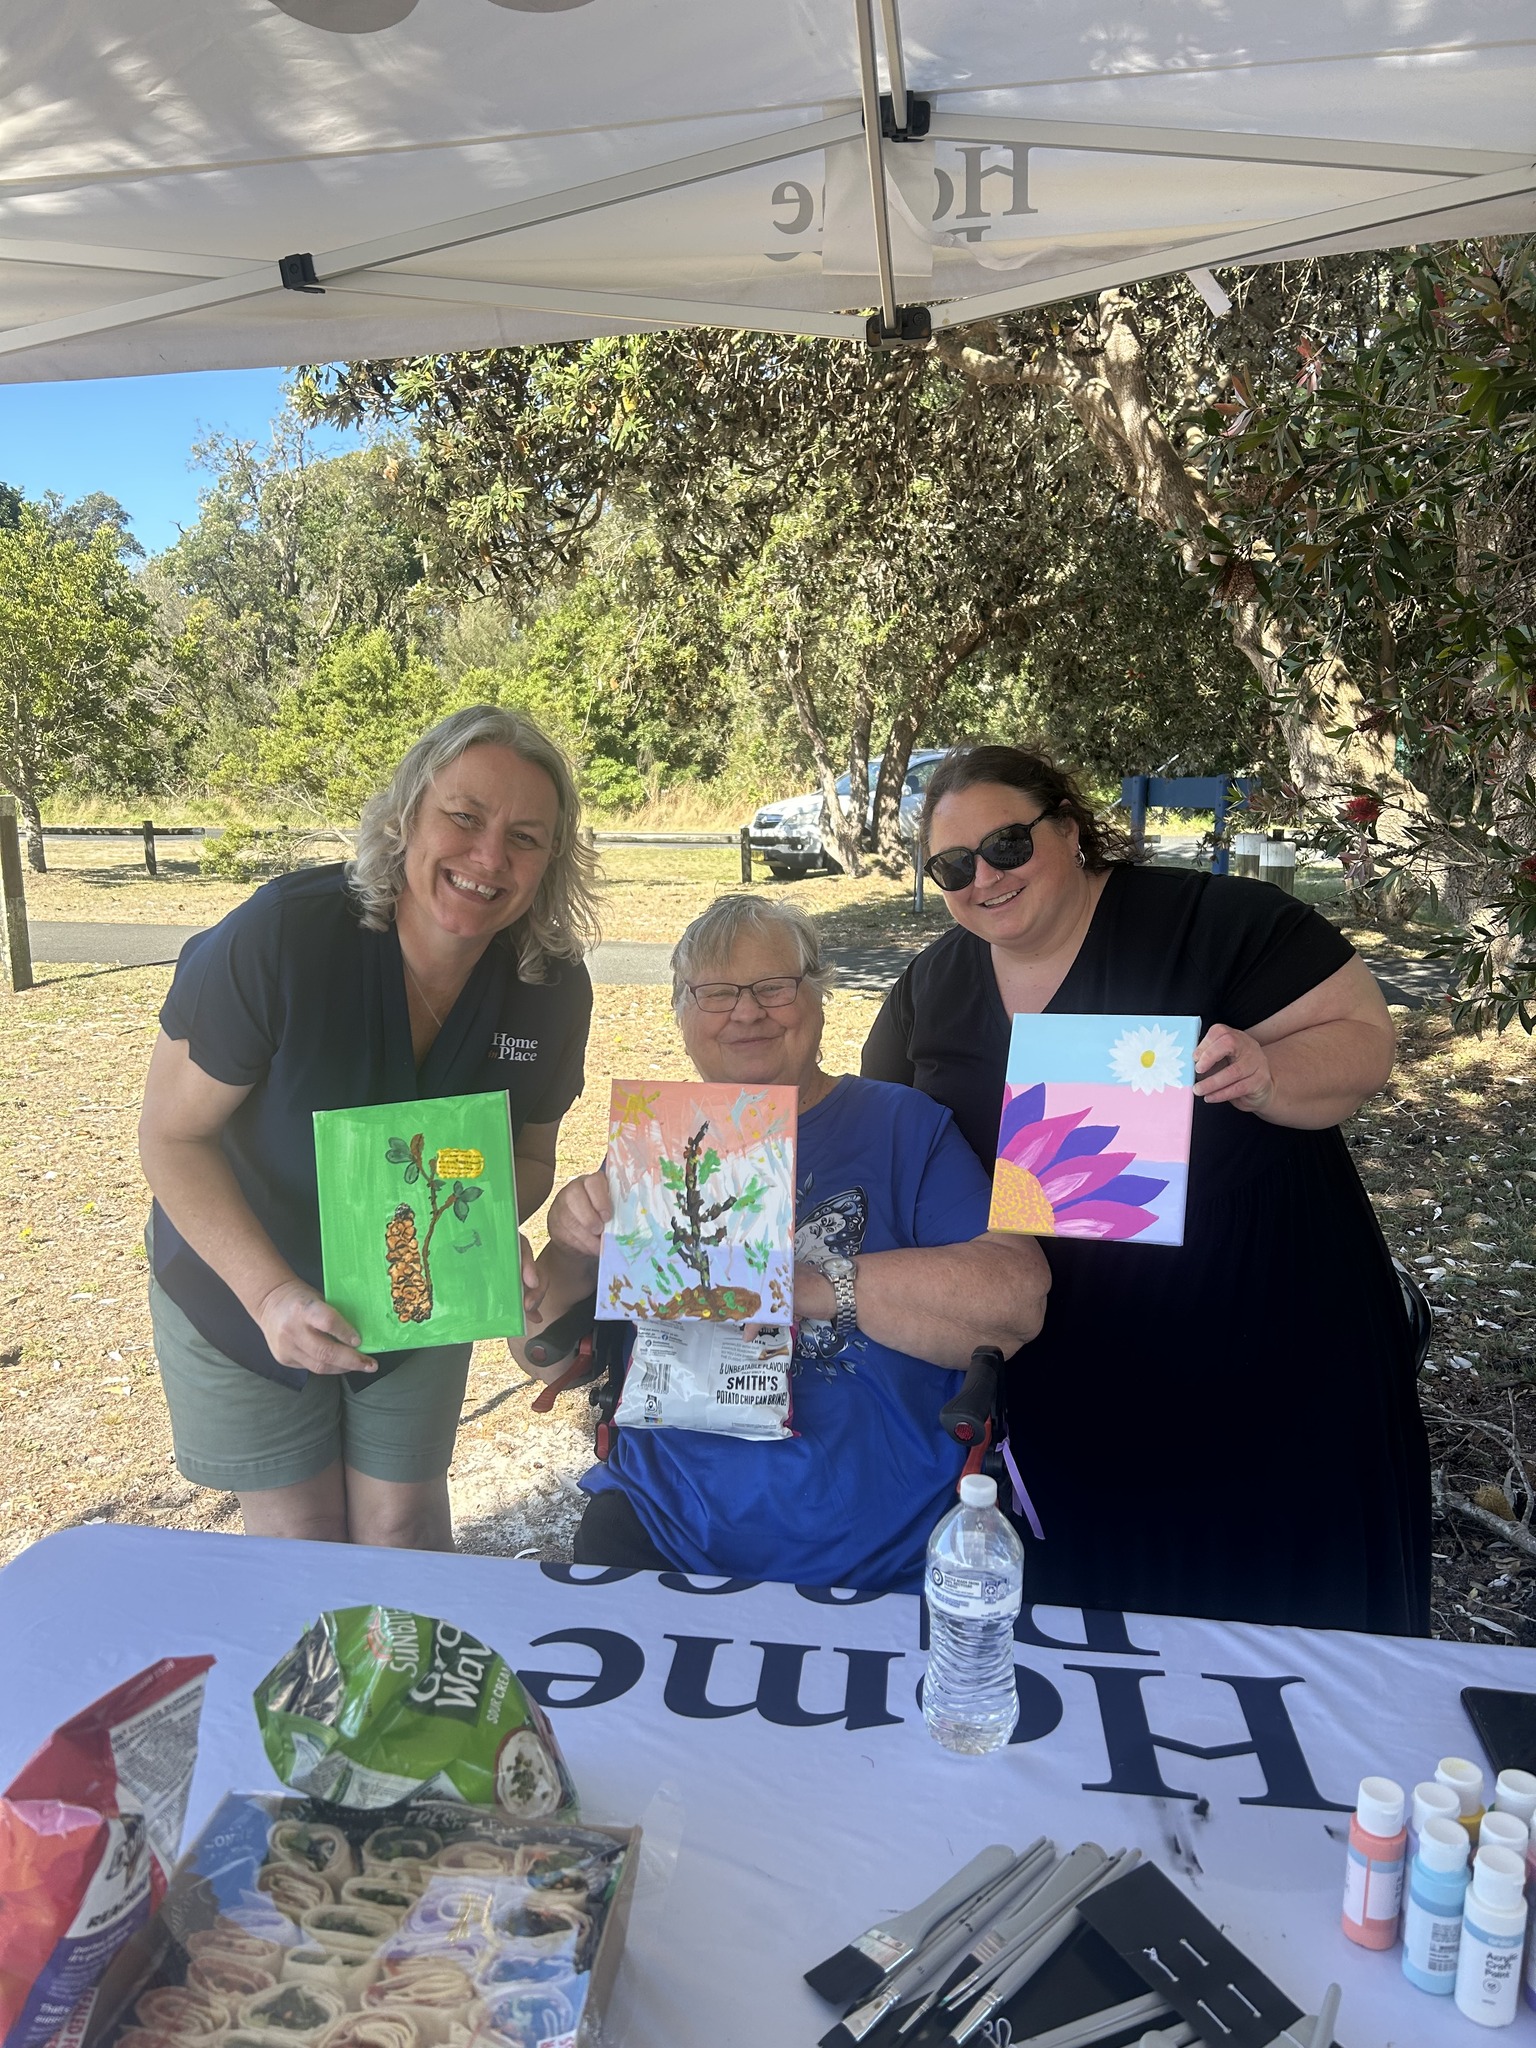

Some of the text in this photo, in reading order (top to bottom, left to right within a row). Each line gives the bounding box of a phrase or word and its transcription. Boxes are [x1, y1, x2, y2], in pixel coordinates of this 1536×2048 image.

[492, 1032, 538, 1049] Home
[498, 1046, 538, 1061] Place
[720, 1363, 724, 1374] &
[725, 1364, 761, 1374] UNBEATABLE
[727, 1375, 778, 1391] SMITH'S
[717, 1390, 739, 1405] POTATO
[740, 1394, 754, 1405] CHIP
[755, 1395, 768, 1405] CAN
[486, 1697, 502, 1724] SOUR
[1486, 1952, 1518, 1963] Acrylic
[1486, 1961, 1511, 1970] Craft
[1485, 1968, 1510, 1979] Paint
